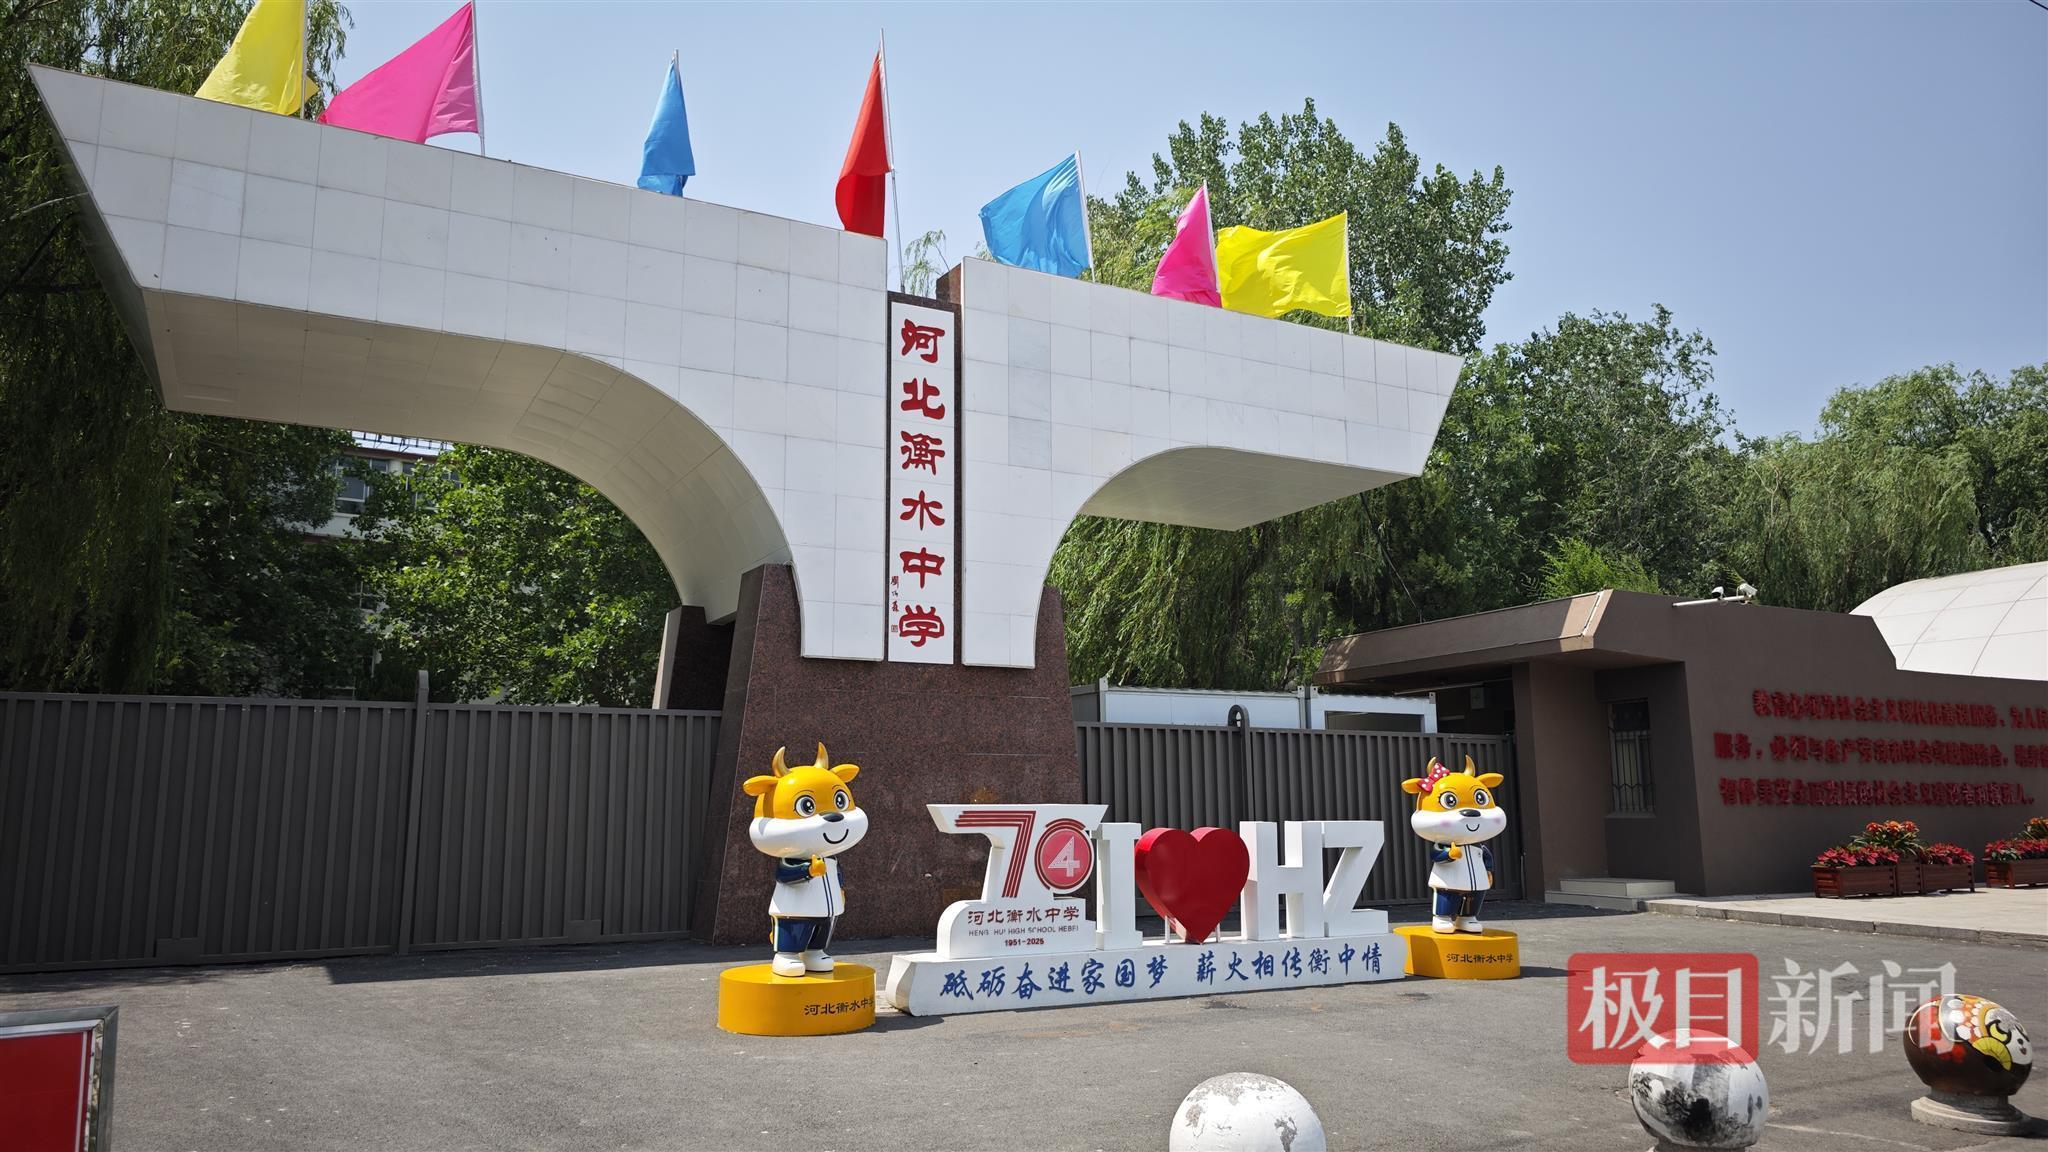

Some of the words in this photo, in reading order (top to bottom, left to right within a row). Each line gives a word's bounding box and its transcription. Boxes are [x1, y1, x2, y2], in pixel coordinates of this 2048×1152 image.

[899, 318, 945, 648] 河北衡水中学
[967, 906, 1080, 926] 河北衡水中学
[1008, 927, 1026, 935] HIGH
[1027, 926, 1057, 934] SCHOOL
[1447, 953, 1513, 963] 河北衡水中学
[939, 955, 1168, 1000] 砥砺奋进家国梦
[1196, 942, 1382, 985] 薪火相传衡中情
